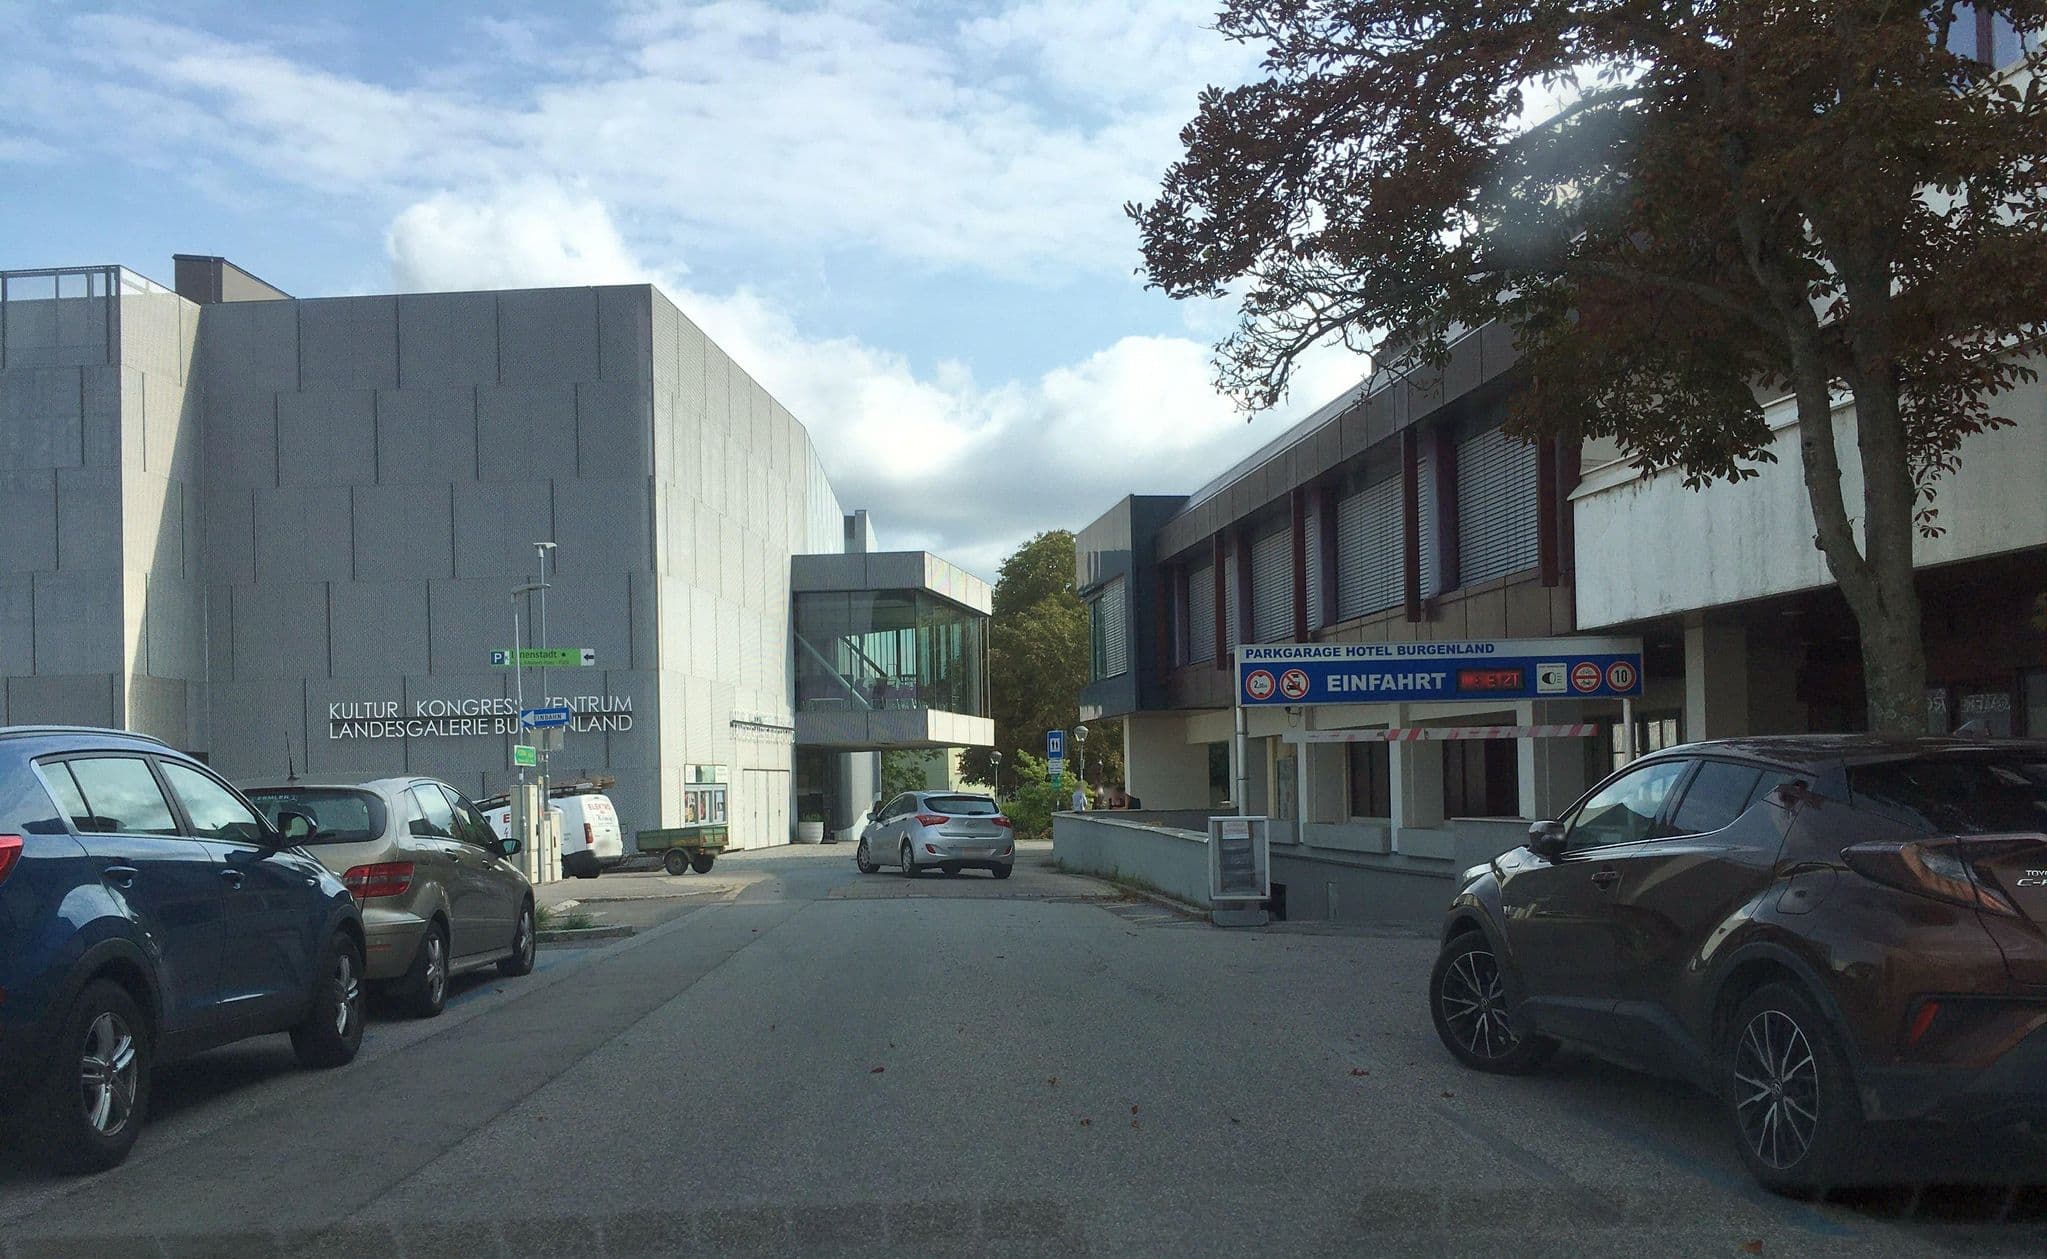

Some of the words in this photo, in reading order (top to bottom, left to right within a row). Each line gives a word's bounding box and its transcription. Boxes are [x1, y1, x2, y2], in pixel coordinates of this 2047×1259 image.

[511, 649, 557, 659] Inenstadt
[1245, 647, 1341, 659] PARKGARAGE
[1346, 645, 1392, 657] HOTEL
[1397, 643, 1495, 656] BURGENLAND
[1327, 672, 1447, 692] EINFAHRT
[1614, 669, 1628, 684] 10
[329, 701, 399, 719] KULTUR
[329, 718, 489, 739] LANDESGALERIE
[495, 715, 633, 735] BUNLAND
